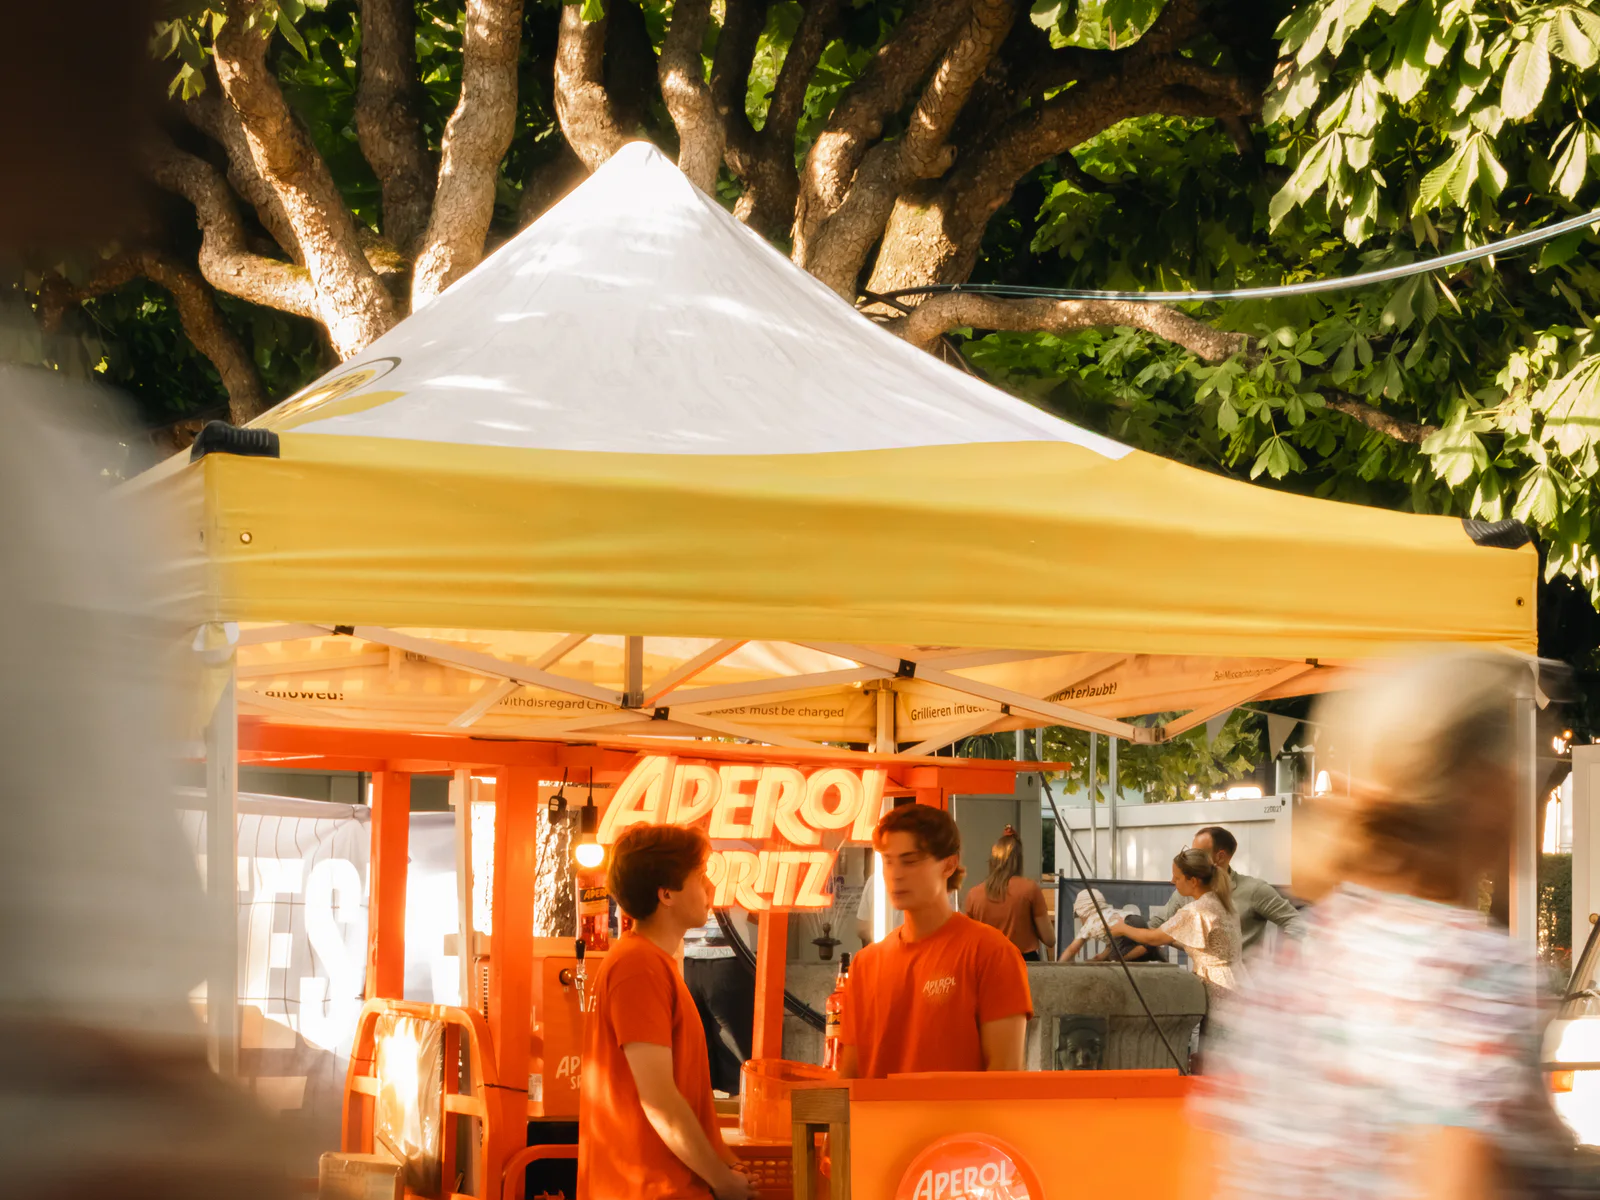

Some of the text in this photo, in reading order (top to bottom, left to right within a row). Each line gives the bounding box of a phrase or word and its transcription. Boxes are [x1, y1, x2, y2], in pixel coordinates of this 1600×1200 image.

[1075, 682, 1117, 698] erlaubt!
[750, 706, 779, 716] must
[781, 706, 795, 716] be
[798, 707, 845, 719] charged
[911, 705, 951, 721] Grillieren
[953, 702, 965, 715] im
[595, 755, 888, 846] APEROL
[706, 850, 839, 911] PRITZ
[555, 1055, 581, 1079] AP
